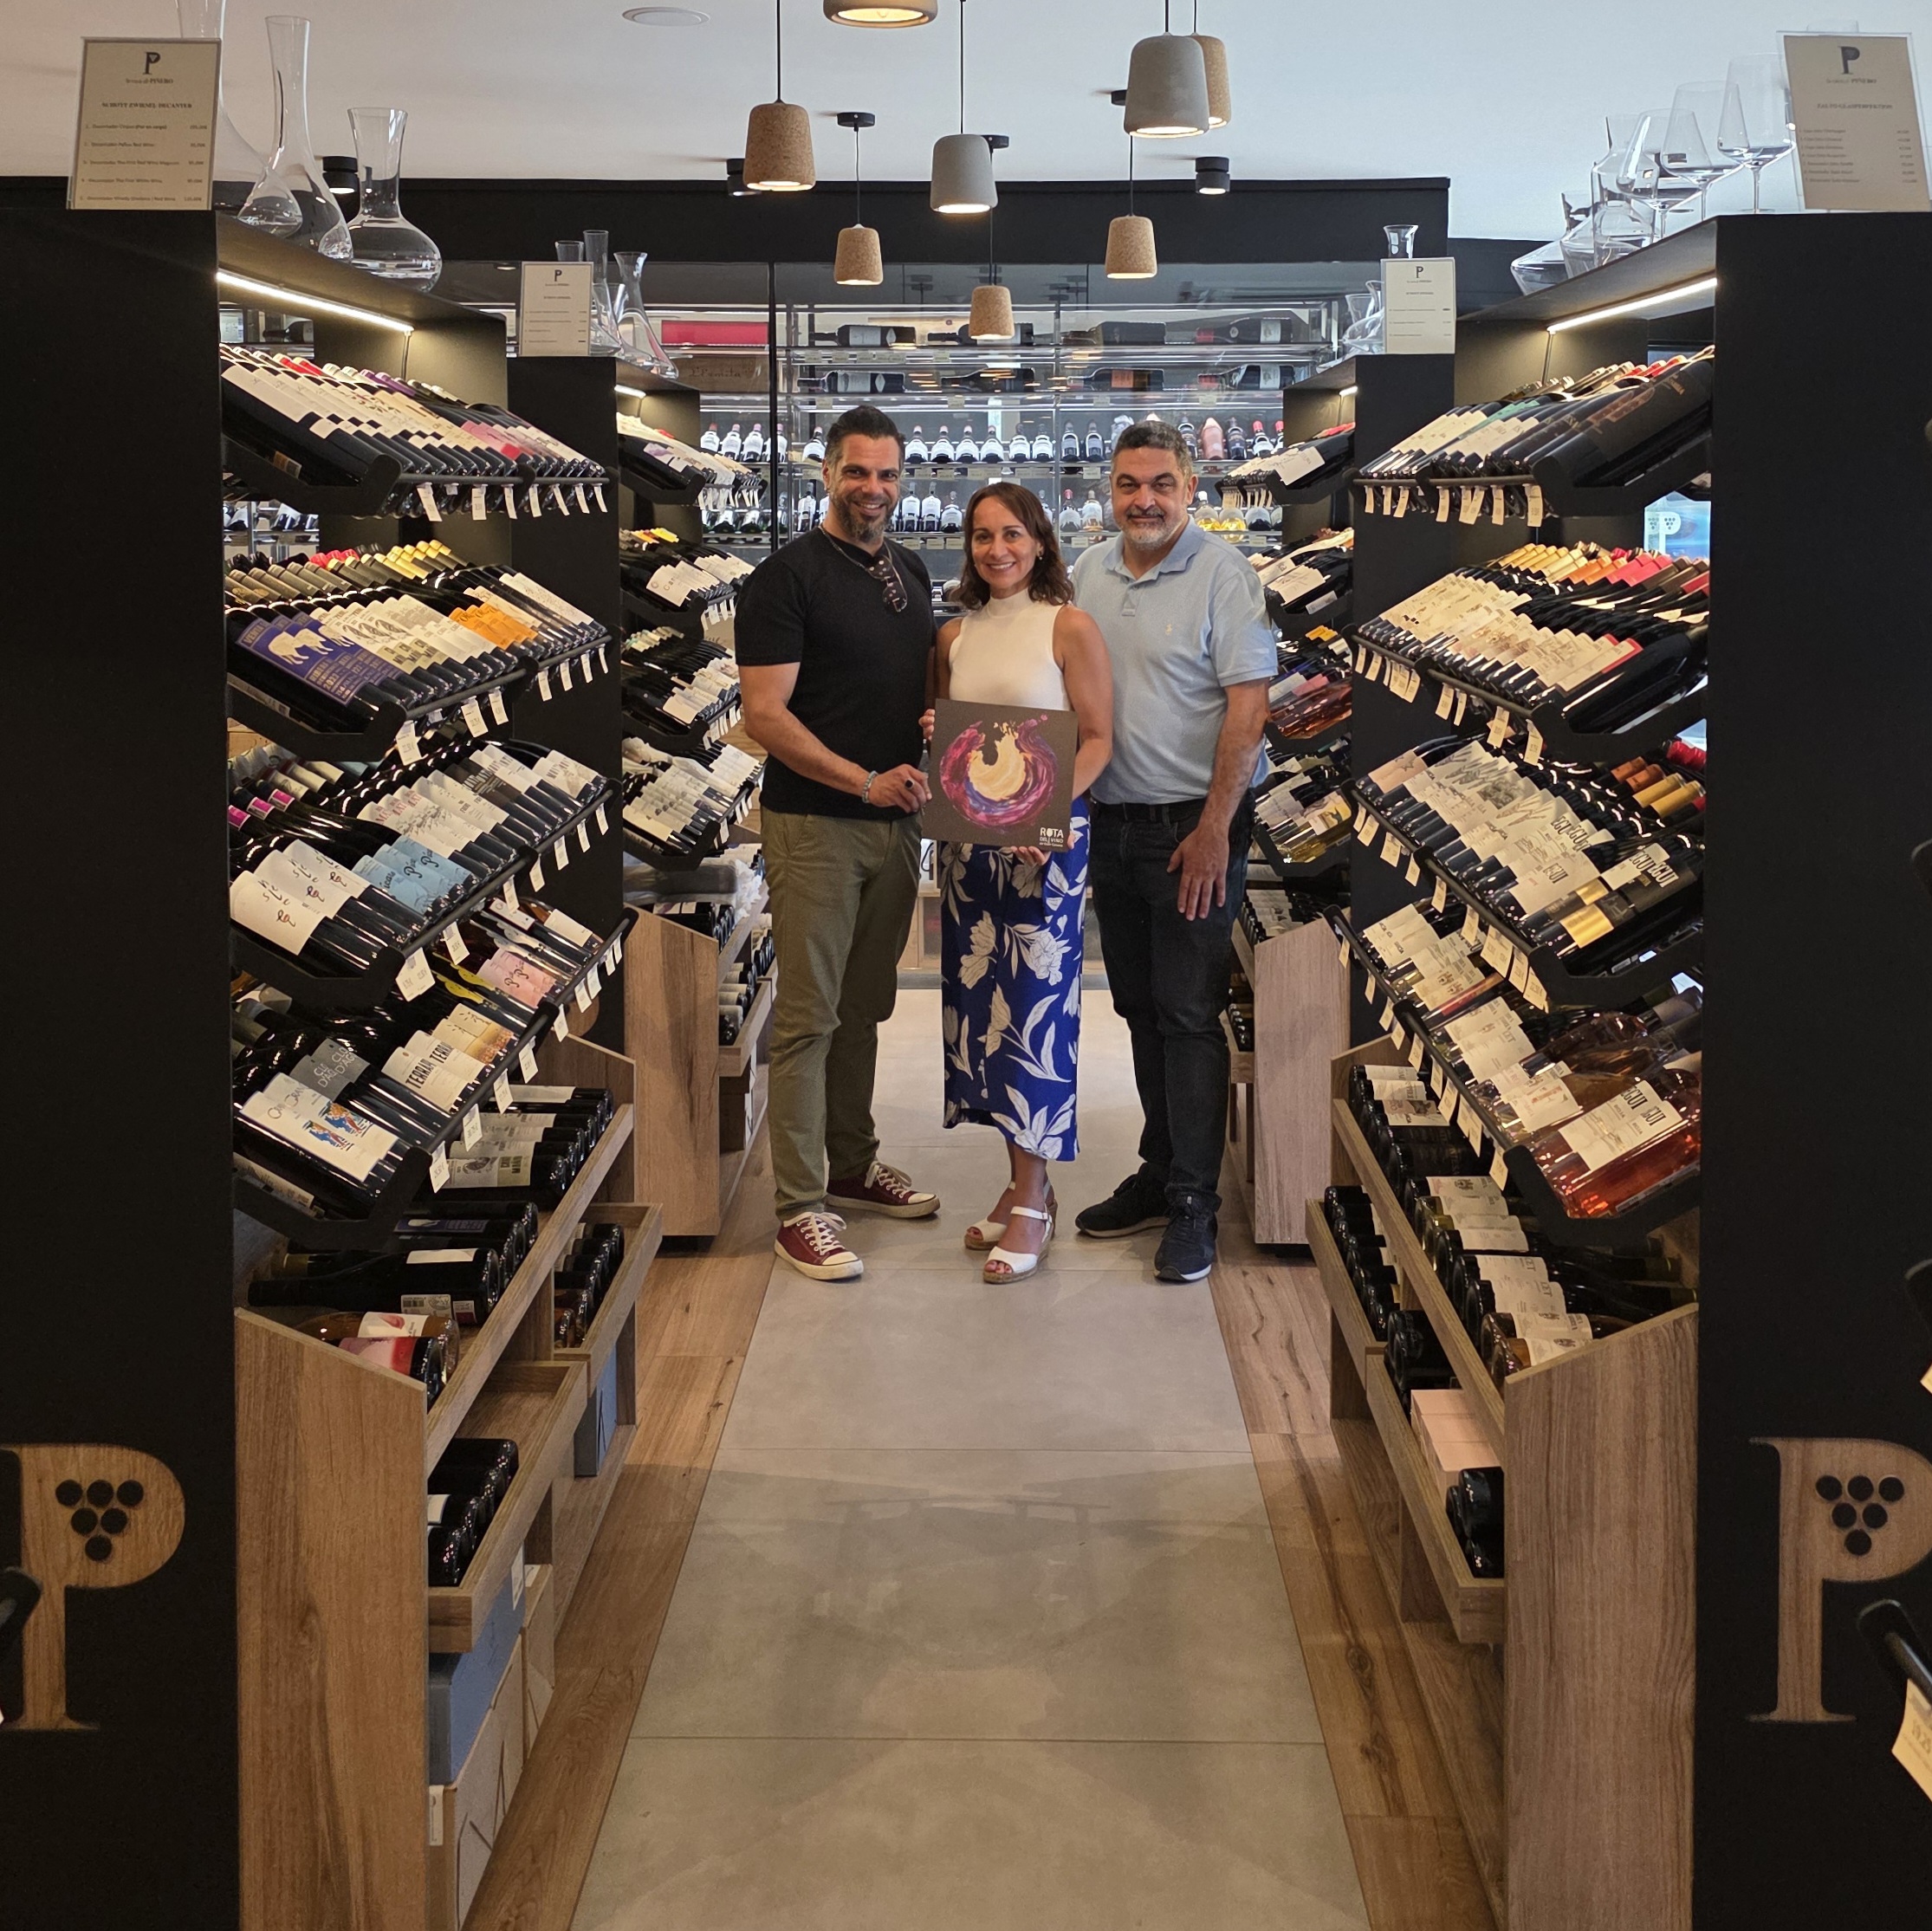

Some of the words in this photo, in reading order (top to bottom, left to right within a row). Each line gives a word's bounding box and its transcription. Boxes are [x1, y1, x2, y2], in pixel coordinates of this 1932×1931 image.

[143, 52, 160, 75] P
[1838, 46, 1860, 75] P
[554, 269, 562, 282] P
[1416, 266, 1424, 278] P
[0, 1442, 185, 1730] P
[1746, 1436, 1932, 1723] P
